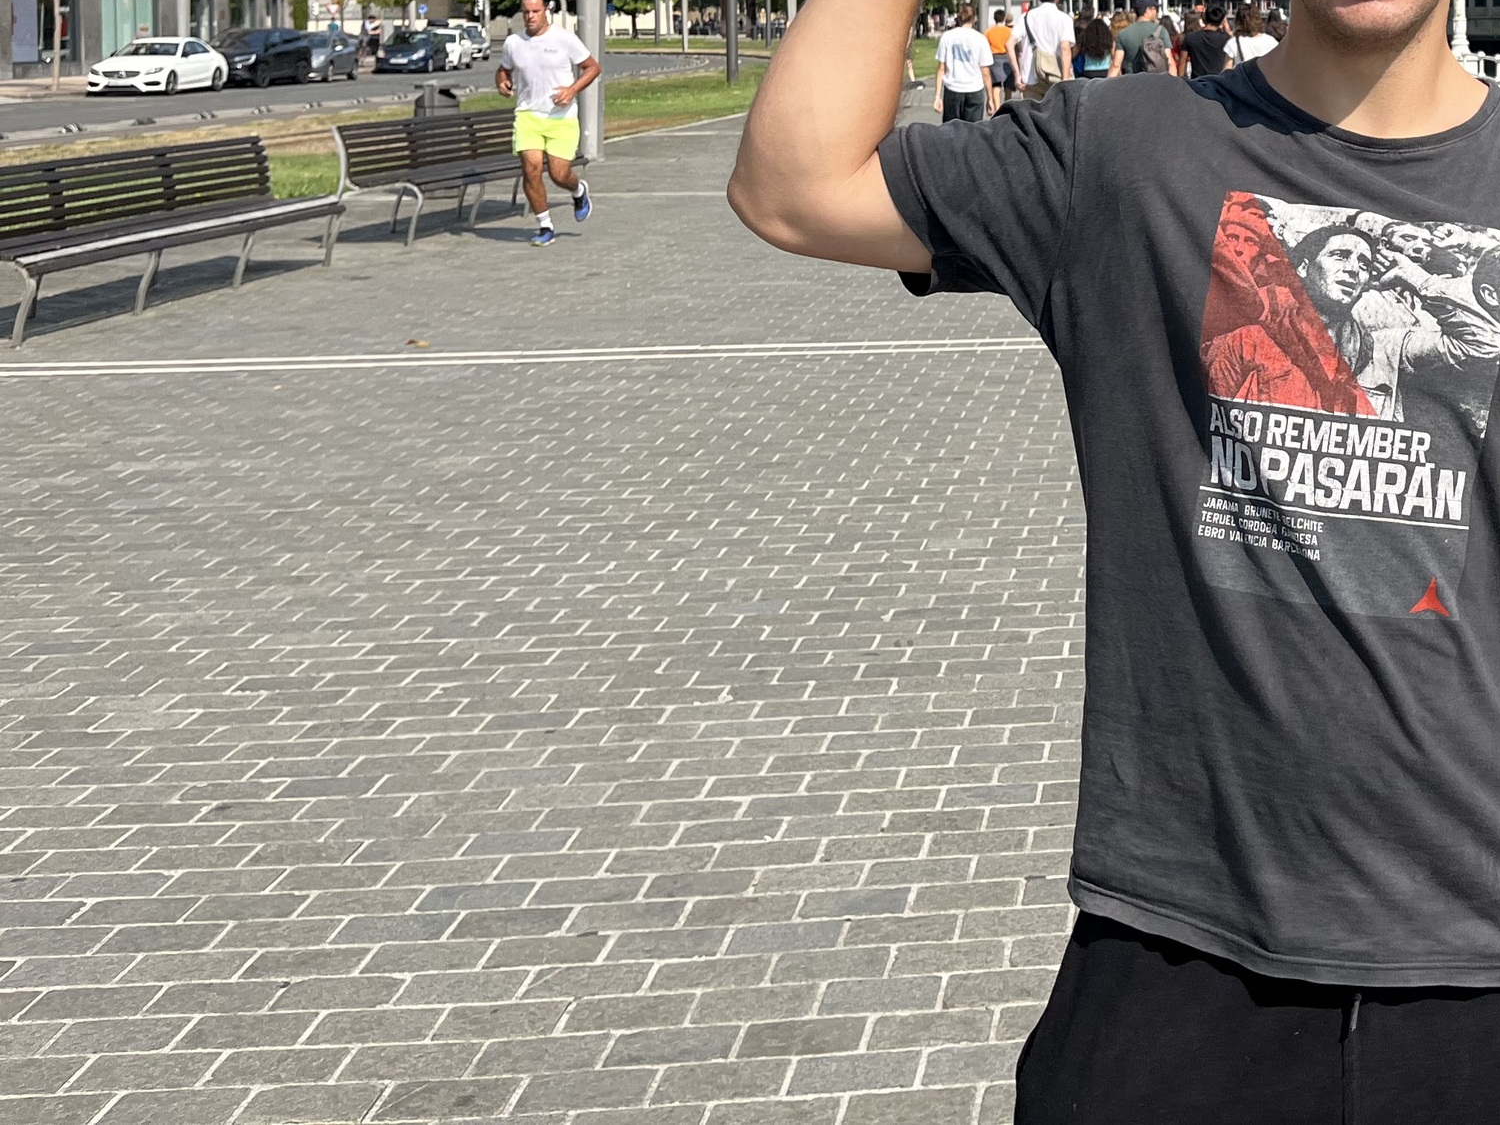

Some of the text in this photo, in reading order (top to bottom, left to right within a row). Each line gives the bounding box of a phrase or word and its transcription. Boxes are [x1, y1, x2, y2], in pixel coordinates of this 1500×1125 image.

[1210, 402, 1432, 464] ALSO REMEMBER
[1210, 435, 1467, 521] NO PASARÁN
[1201, 510, 1236, 527] TERUEL
[1239, 518, 1278, 535] CORDOBA
[1244, 504, 1282, 522] BRUNETE
[1198, 524, 1226, 540] EBRO
